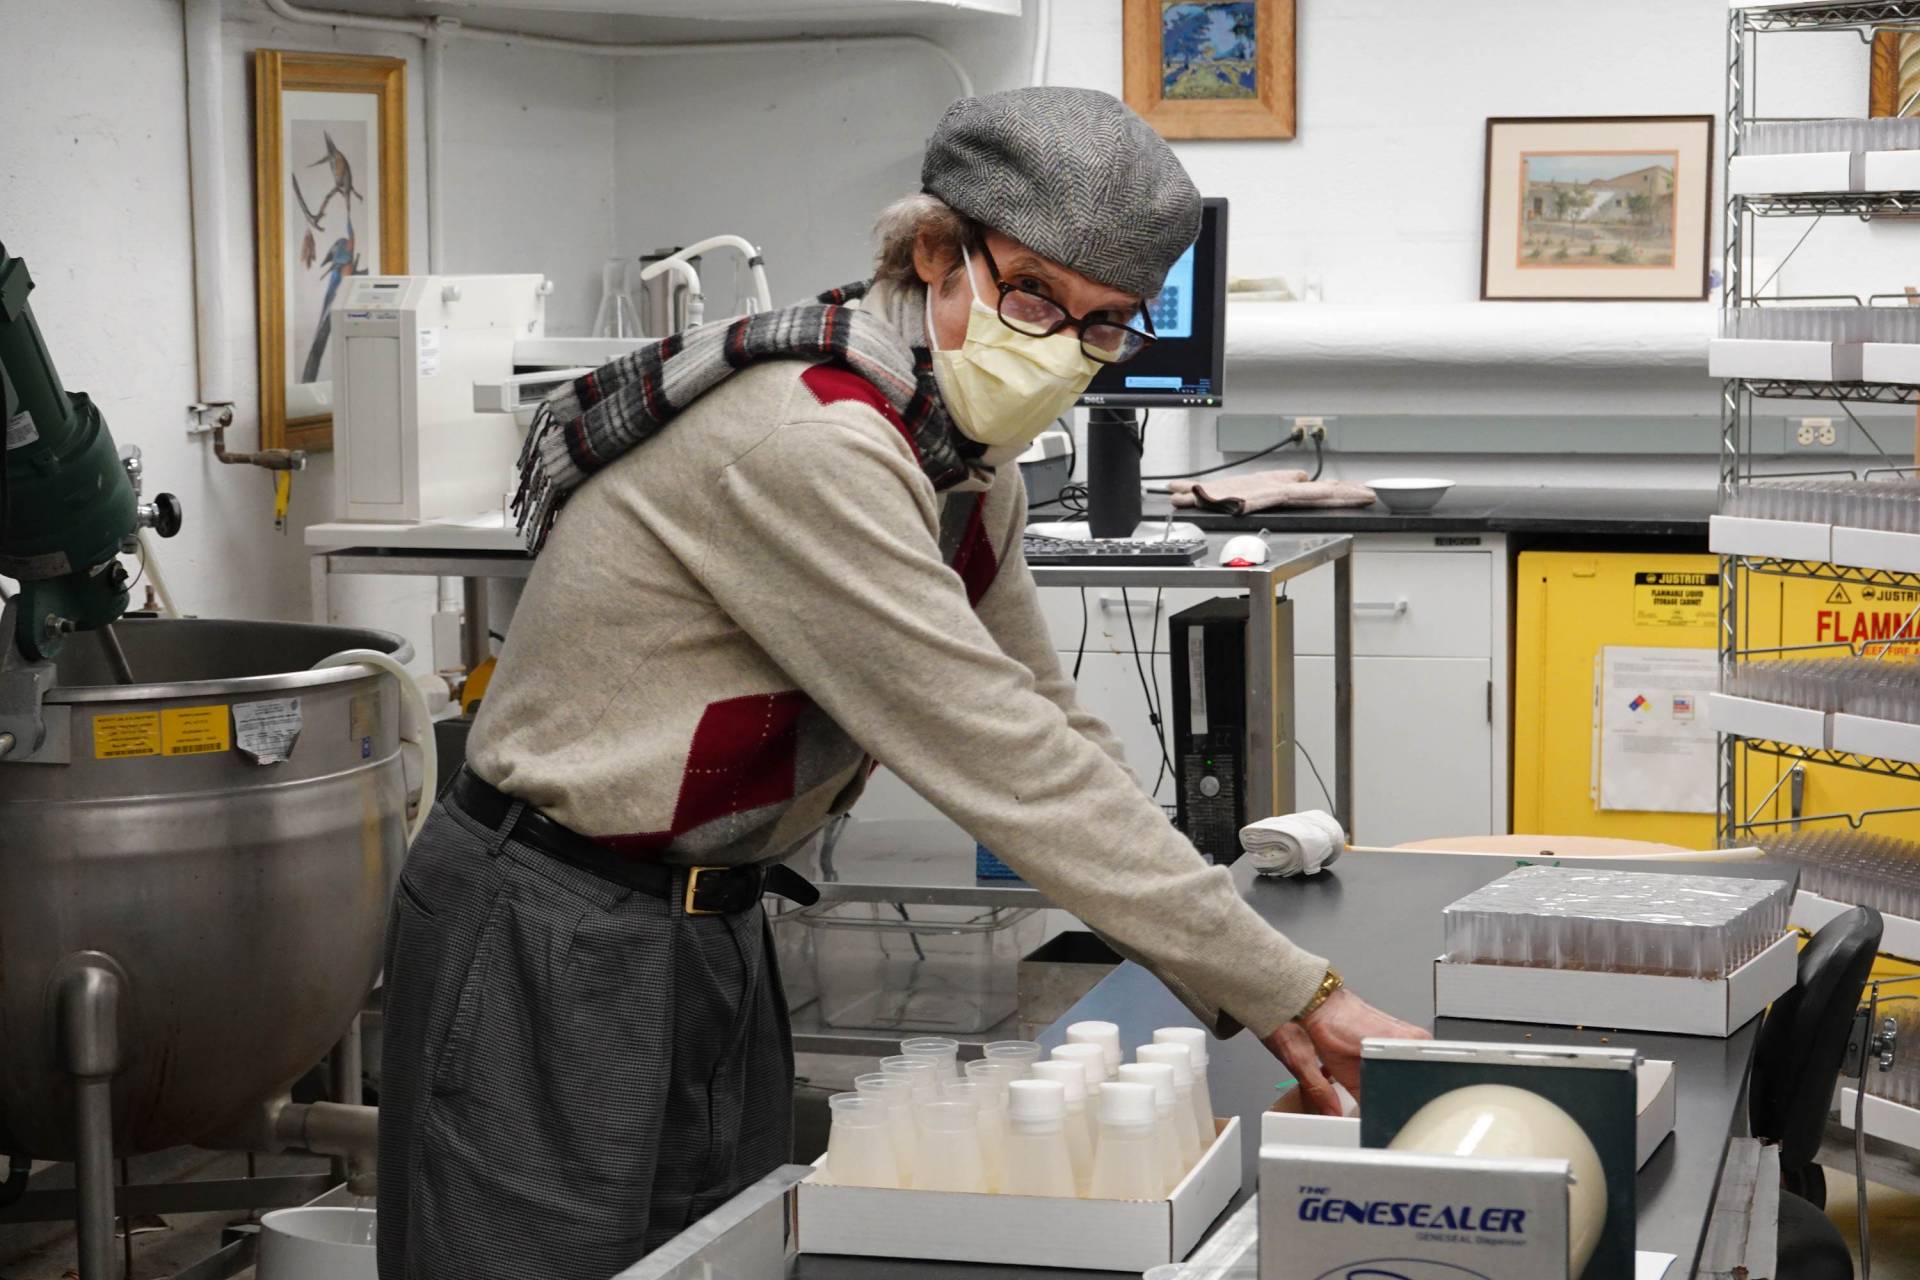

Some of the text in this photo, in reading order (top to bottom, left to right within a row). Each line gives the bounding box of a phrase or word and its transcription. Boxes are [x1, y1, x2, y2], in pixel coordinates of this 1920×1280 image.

[1084, 396, 1105, 404] DELL
[1658, 574, 1706, 585] JUSTRITE
[1652, 590, 1683, 598] FLAMMABLE
[1876, 590, 1920, 602] JUSTRI
[1298, 1186, 1330, 1195] THE
[1299, 1197, 1525, 1233] GENESEALER
[1415, 1231, 1527, 1247] GENESEAL Dispenser
